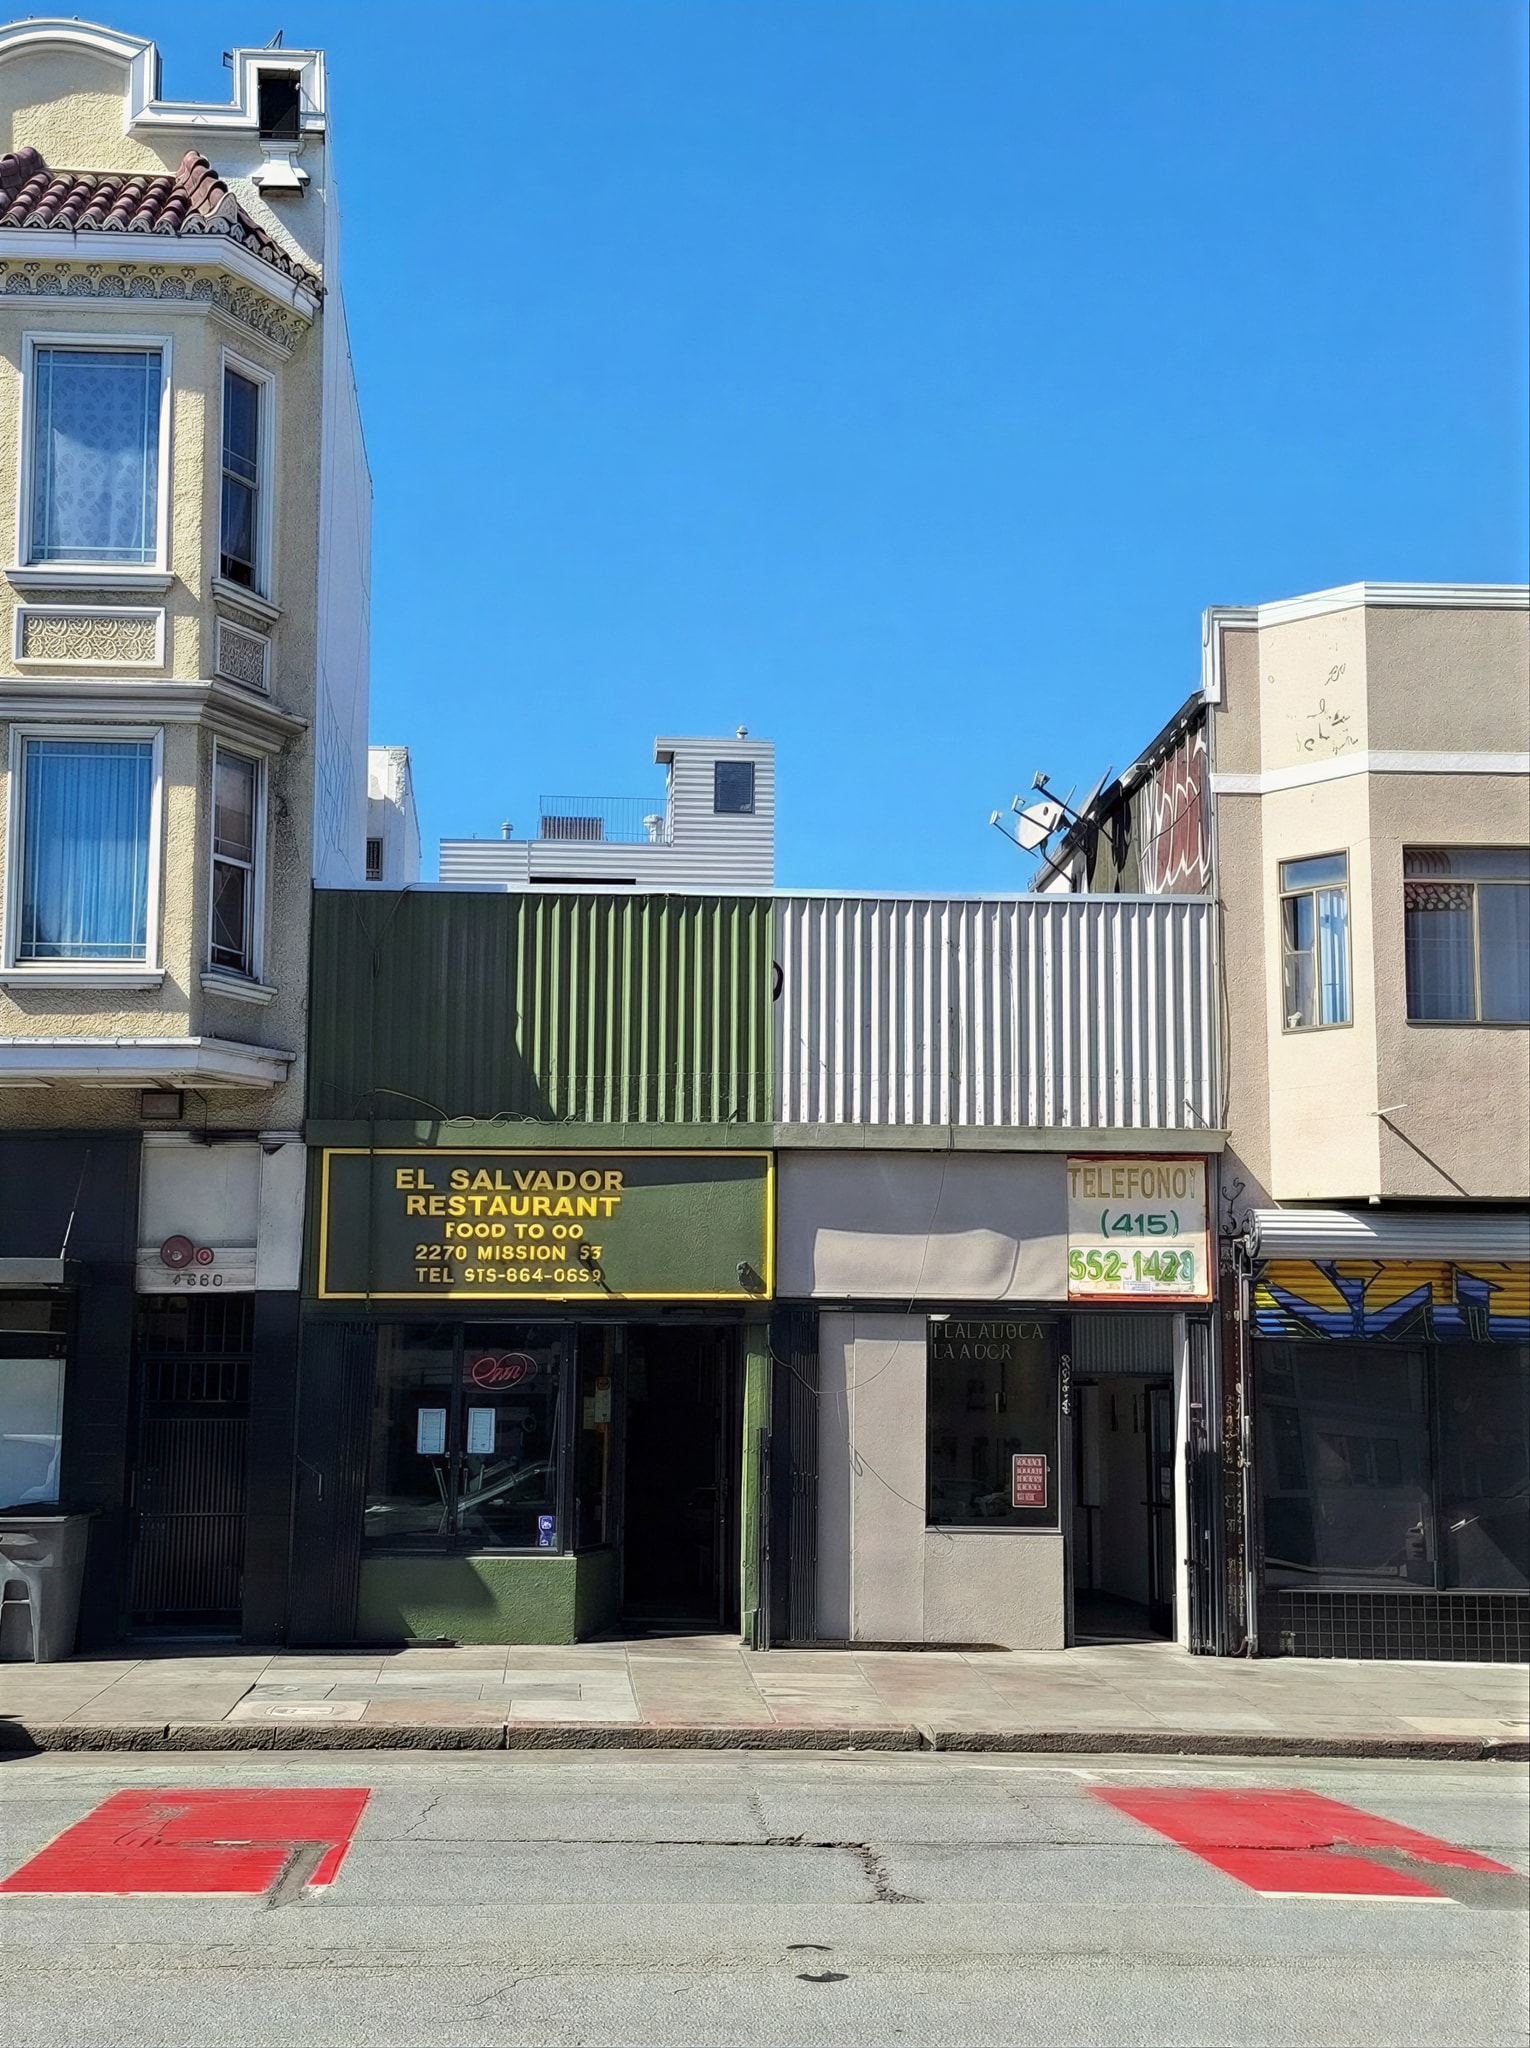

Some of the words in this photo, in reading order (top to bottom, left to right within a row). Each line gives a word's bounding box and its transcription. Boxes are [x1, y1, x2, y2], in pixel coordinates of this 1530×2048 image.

[395, 1168, 435, 1190] EL
[449, 1168, 625, 1191] SALVADOR
[406, 1194, 622, 1217] RESTAURANT
[445, 1222, 506, 1239] FOOD
[514, 1222, 545, 1239] TO
[1101, 1208, 1179, 1239] (415)
[415, 1244, 467, 1260] 2270
[415, 1267, 455, 1283] TEL
